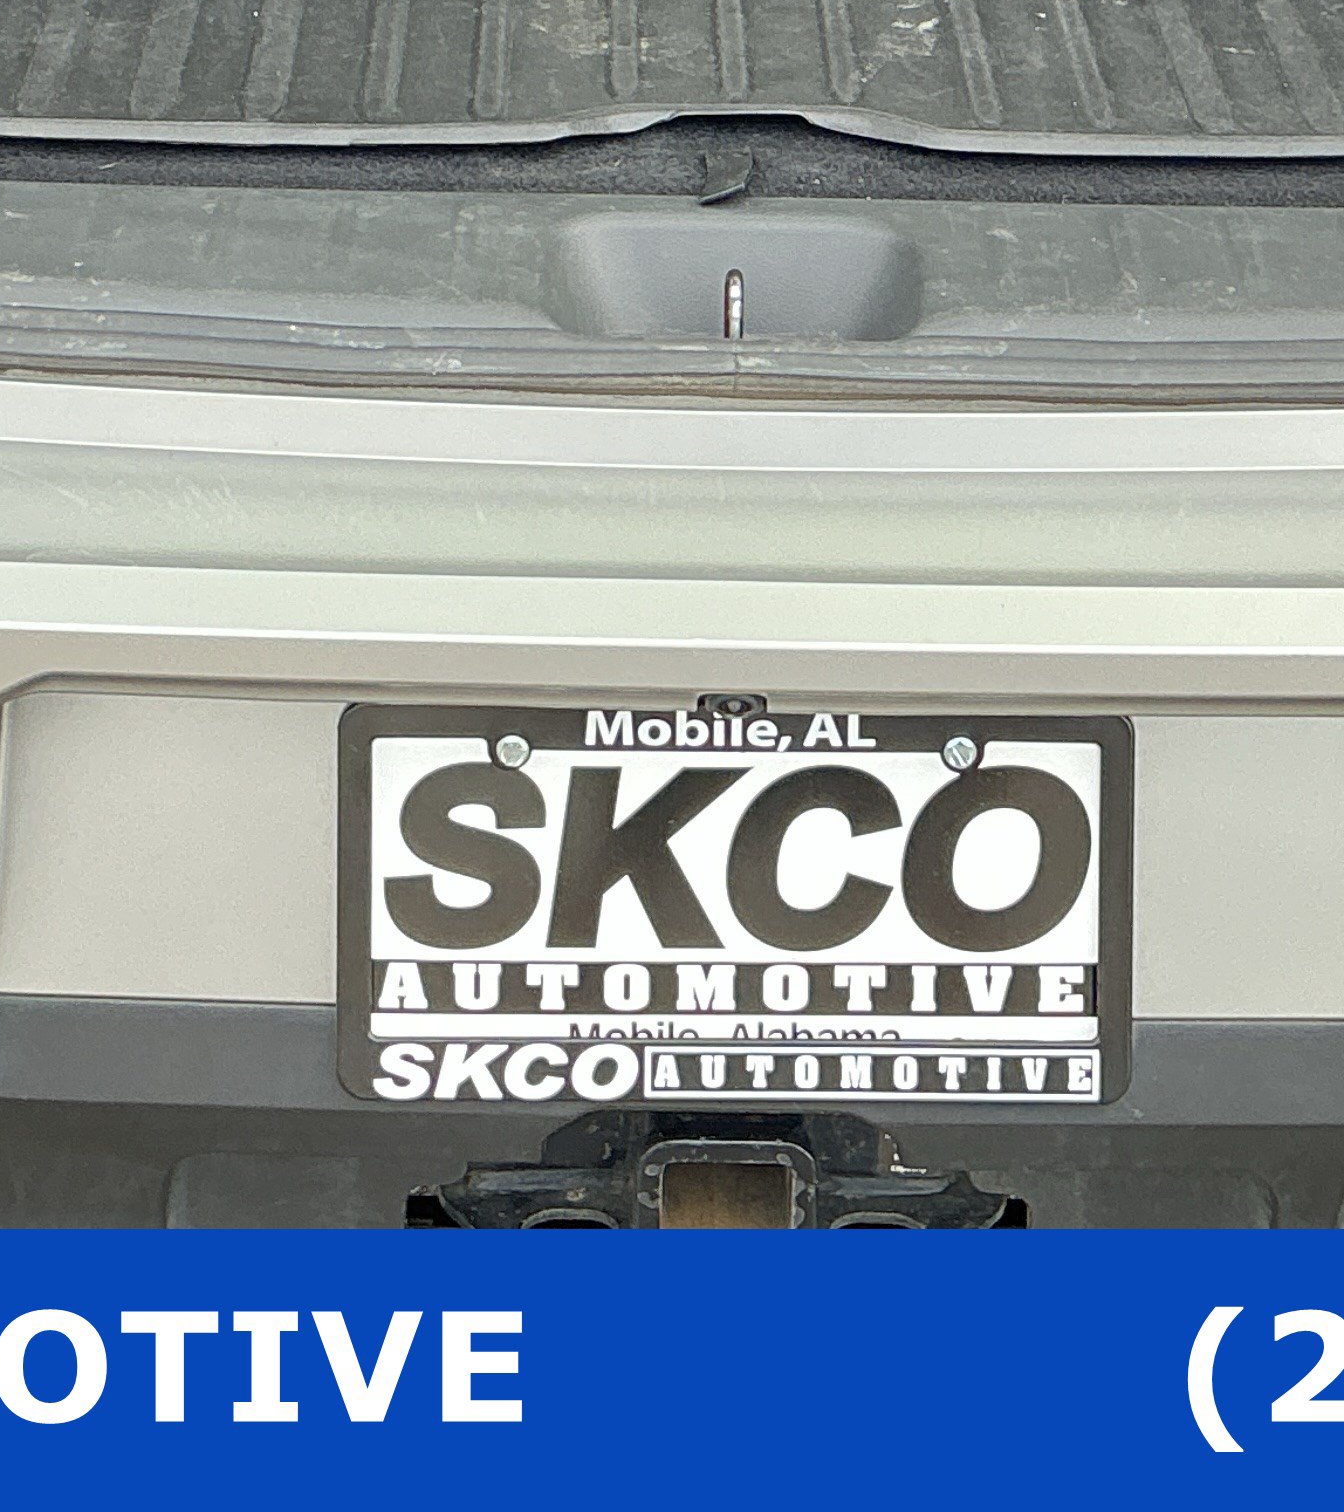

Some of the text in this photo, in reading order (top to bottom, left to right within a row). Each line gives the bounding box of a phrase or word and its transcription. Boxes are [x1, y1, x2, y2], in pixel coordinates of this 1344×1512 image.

[585, 710, 877, 752] Mobile, AL
[383, 762, 1093, 953] SKCO
[378, 962, 1085, 1014] AUTOMOTIVE
[372, 1042, 1093, 1101] SKCO AUTOMOTIVE
